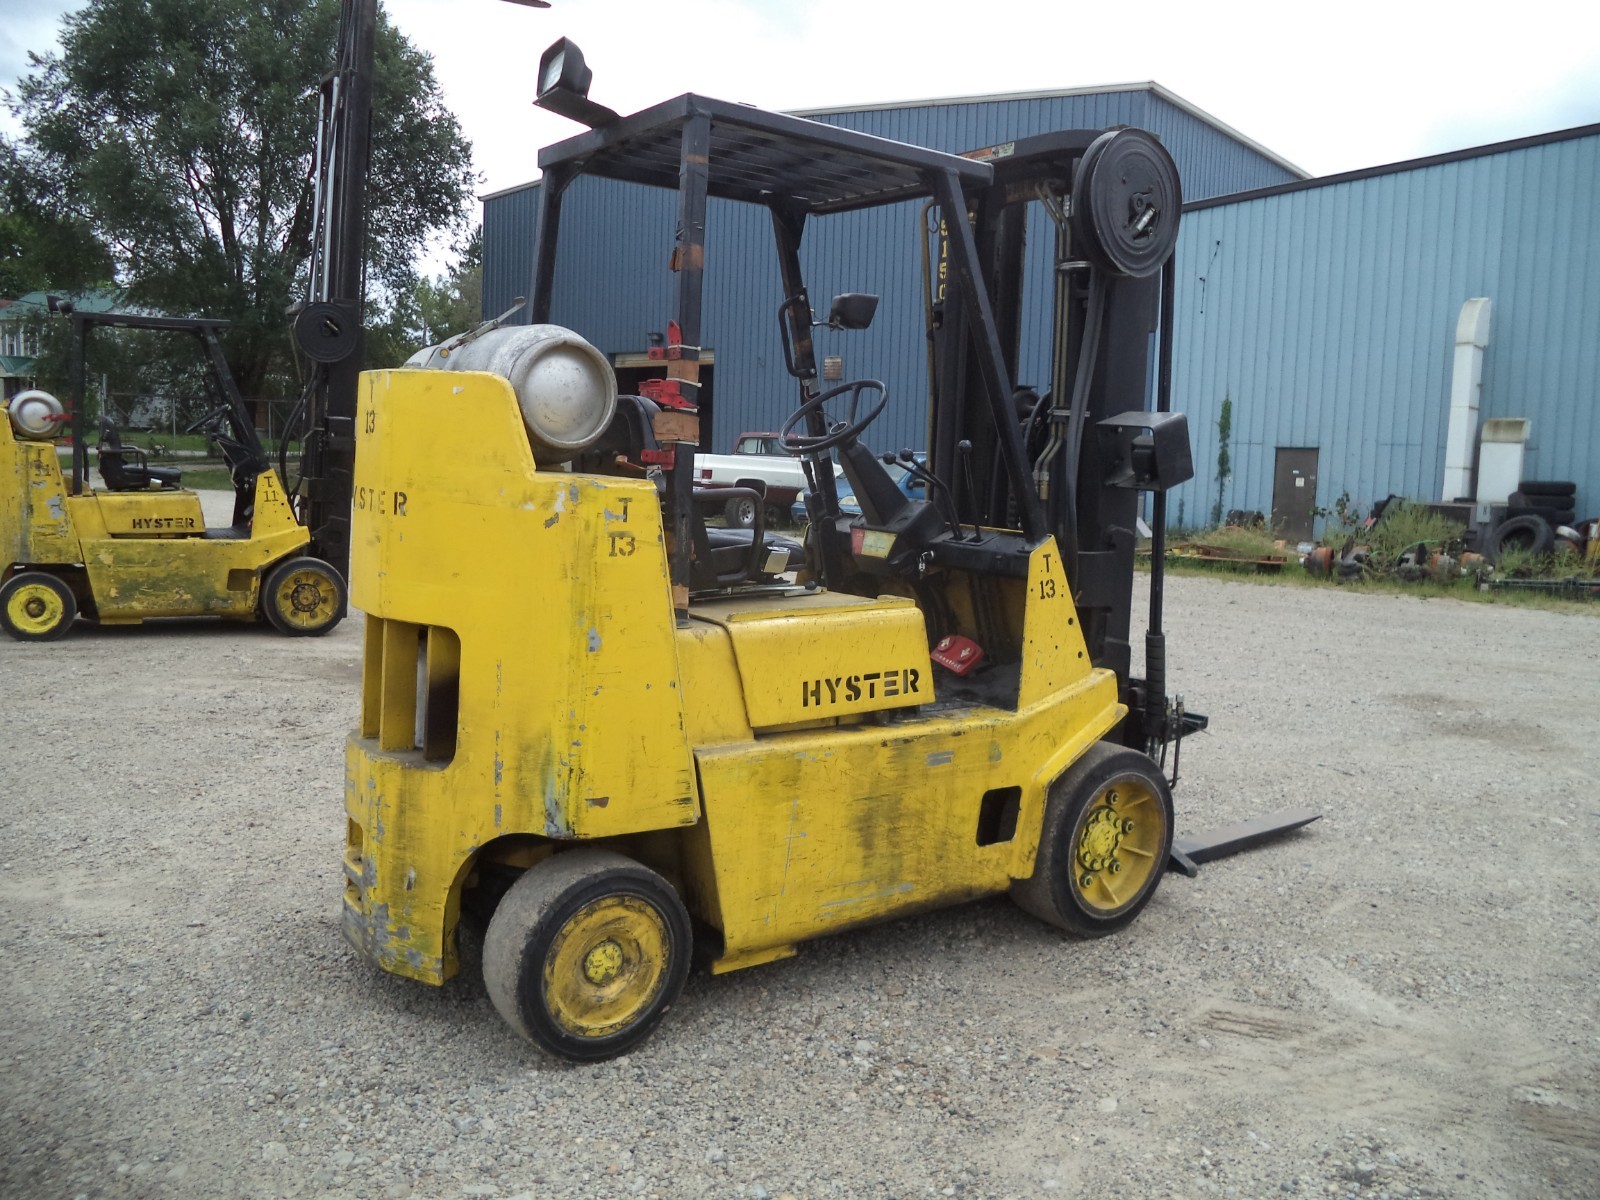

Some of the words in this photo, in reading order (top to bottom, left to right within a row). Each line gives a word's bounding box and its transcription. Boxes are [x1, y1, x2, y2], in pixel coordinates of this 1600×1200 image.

[365, 409, 376, 433] 13
[263, 490, 279, 502] 11
[618, 497, 633, 522] T
[132, 518, 195, 529] HYSTER
[608, 531, 636, 557] 13
[1043, 554, 1051, 573] T
[1039, 579, 1056, 600] 13
[802, 668, 920, 708] HYSTER
